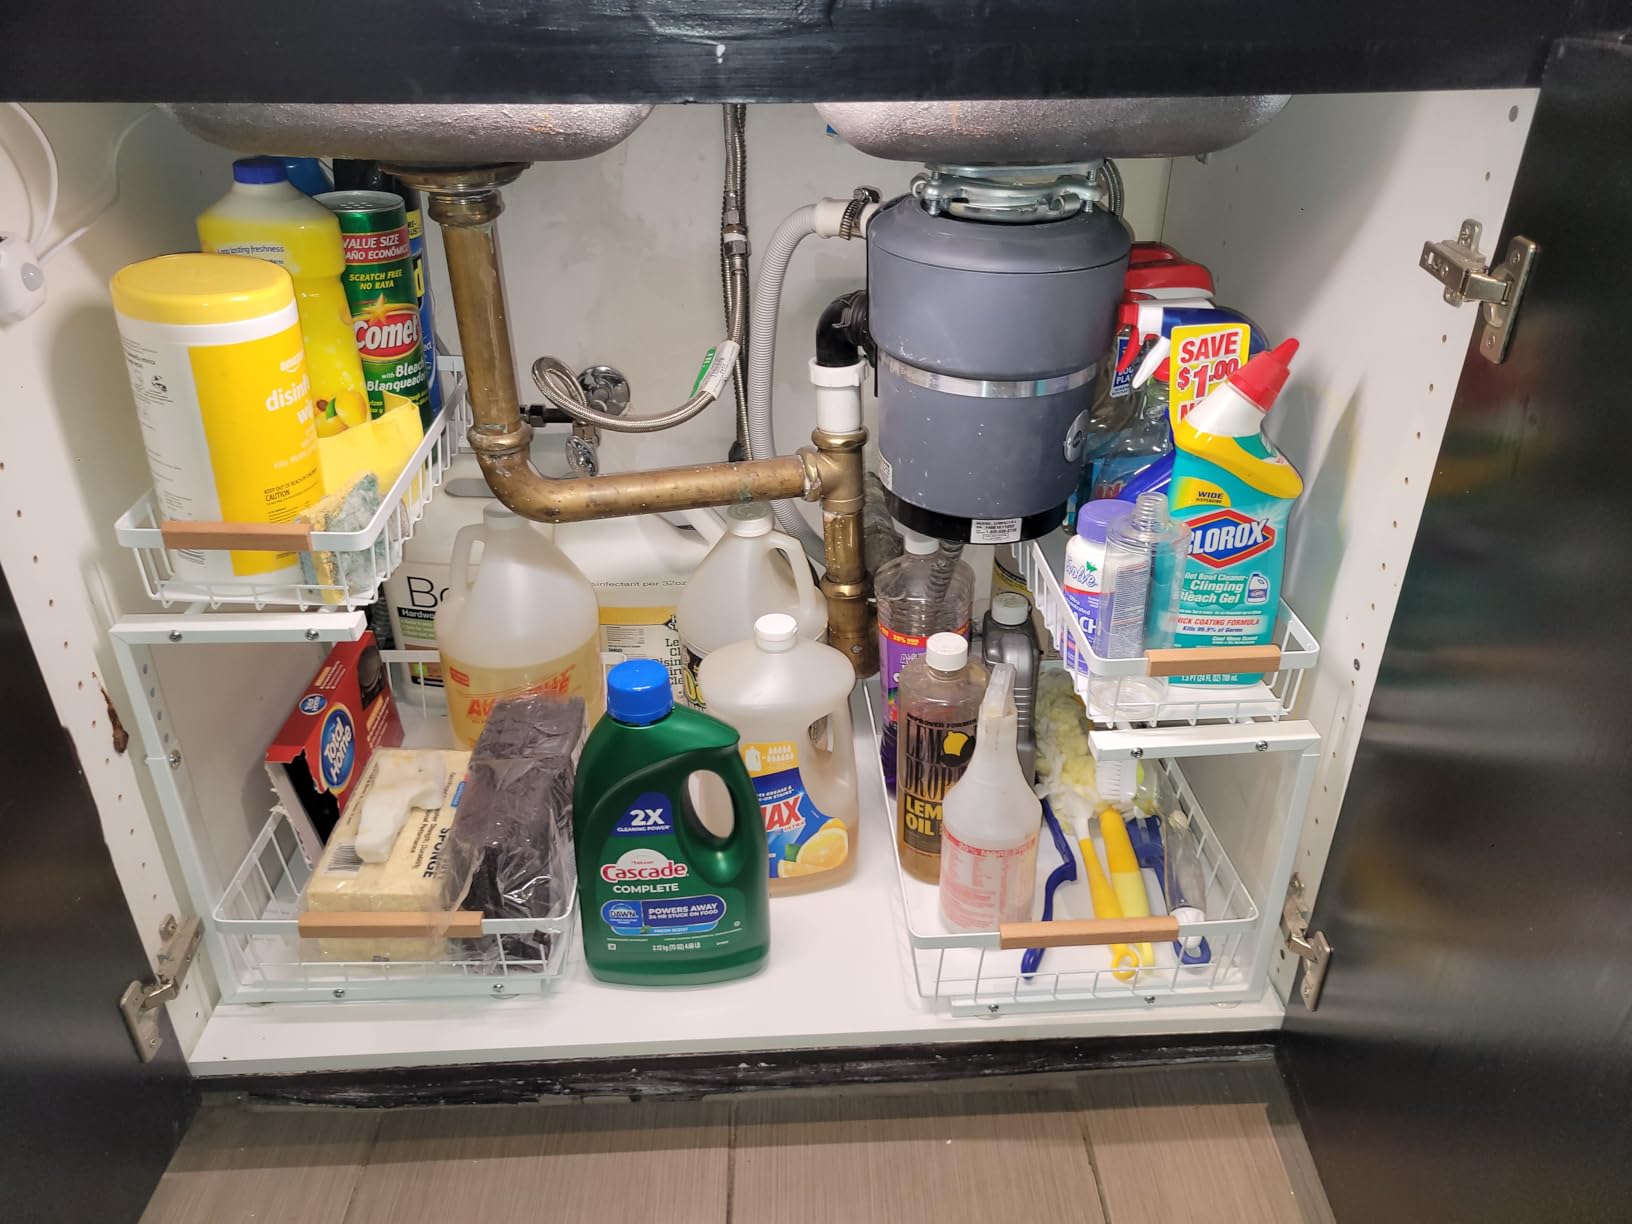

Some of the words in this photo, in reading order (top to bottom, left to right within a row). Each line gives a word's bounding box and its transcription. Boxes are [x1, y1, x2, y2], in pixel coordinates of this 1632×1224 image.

[343, 237, 377, 249] VALUE
[379, 233, 400, 247] SIZE
[250, 245, 285, 254] freshness
[345, 250, 366, 260] AÑO
[349, 271, 386, 282] SCRATCH
[387, 269, 403, 279] FREE
[375, 280, 395, 289] RAYA
[354, 315, 419, 350] Comet
[1179, 331, 1240, 365] SAVE
[1177, 357, 1241, 400] $1.00
[265, 489, 290, 502] CAUTION
[1198, 490, 1224, 500] WIDE
[1198, 572, 1217, 581] Bowl
[1190, 579, 1244, 593] Clinging
[1219, 592, 1241, 604] Gel
[401, 608, 435, 619] Hardwo
[1194, 617, 1226, 626] COATING
[1226, 618, 1260, 626] FORMULA
[324, 716, 344, 764] Total
[330, 725, 352, 784] Home
[906, 795, 943, 821] LEM
[630, 808, 665, 827] 2X
[905, 813, 935, 836] OIL
[423, 827, 450, 879] SPONGE
[601, 860, 687, 882] Cascade
[613, 883, 680, 894] COMPLETE
[609, 910, 637, 918] DAWN
[648, 906, 689, 915] POWERS
[690, 903, 718, 912] AWAY
